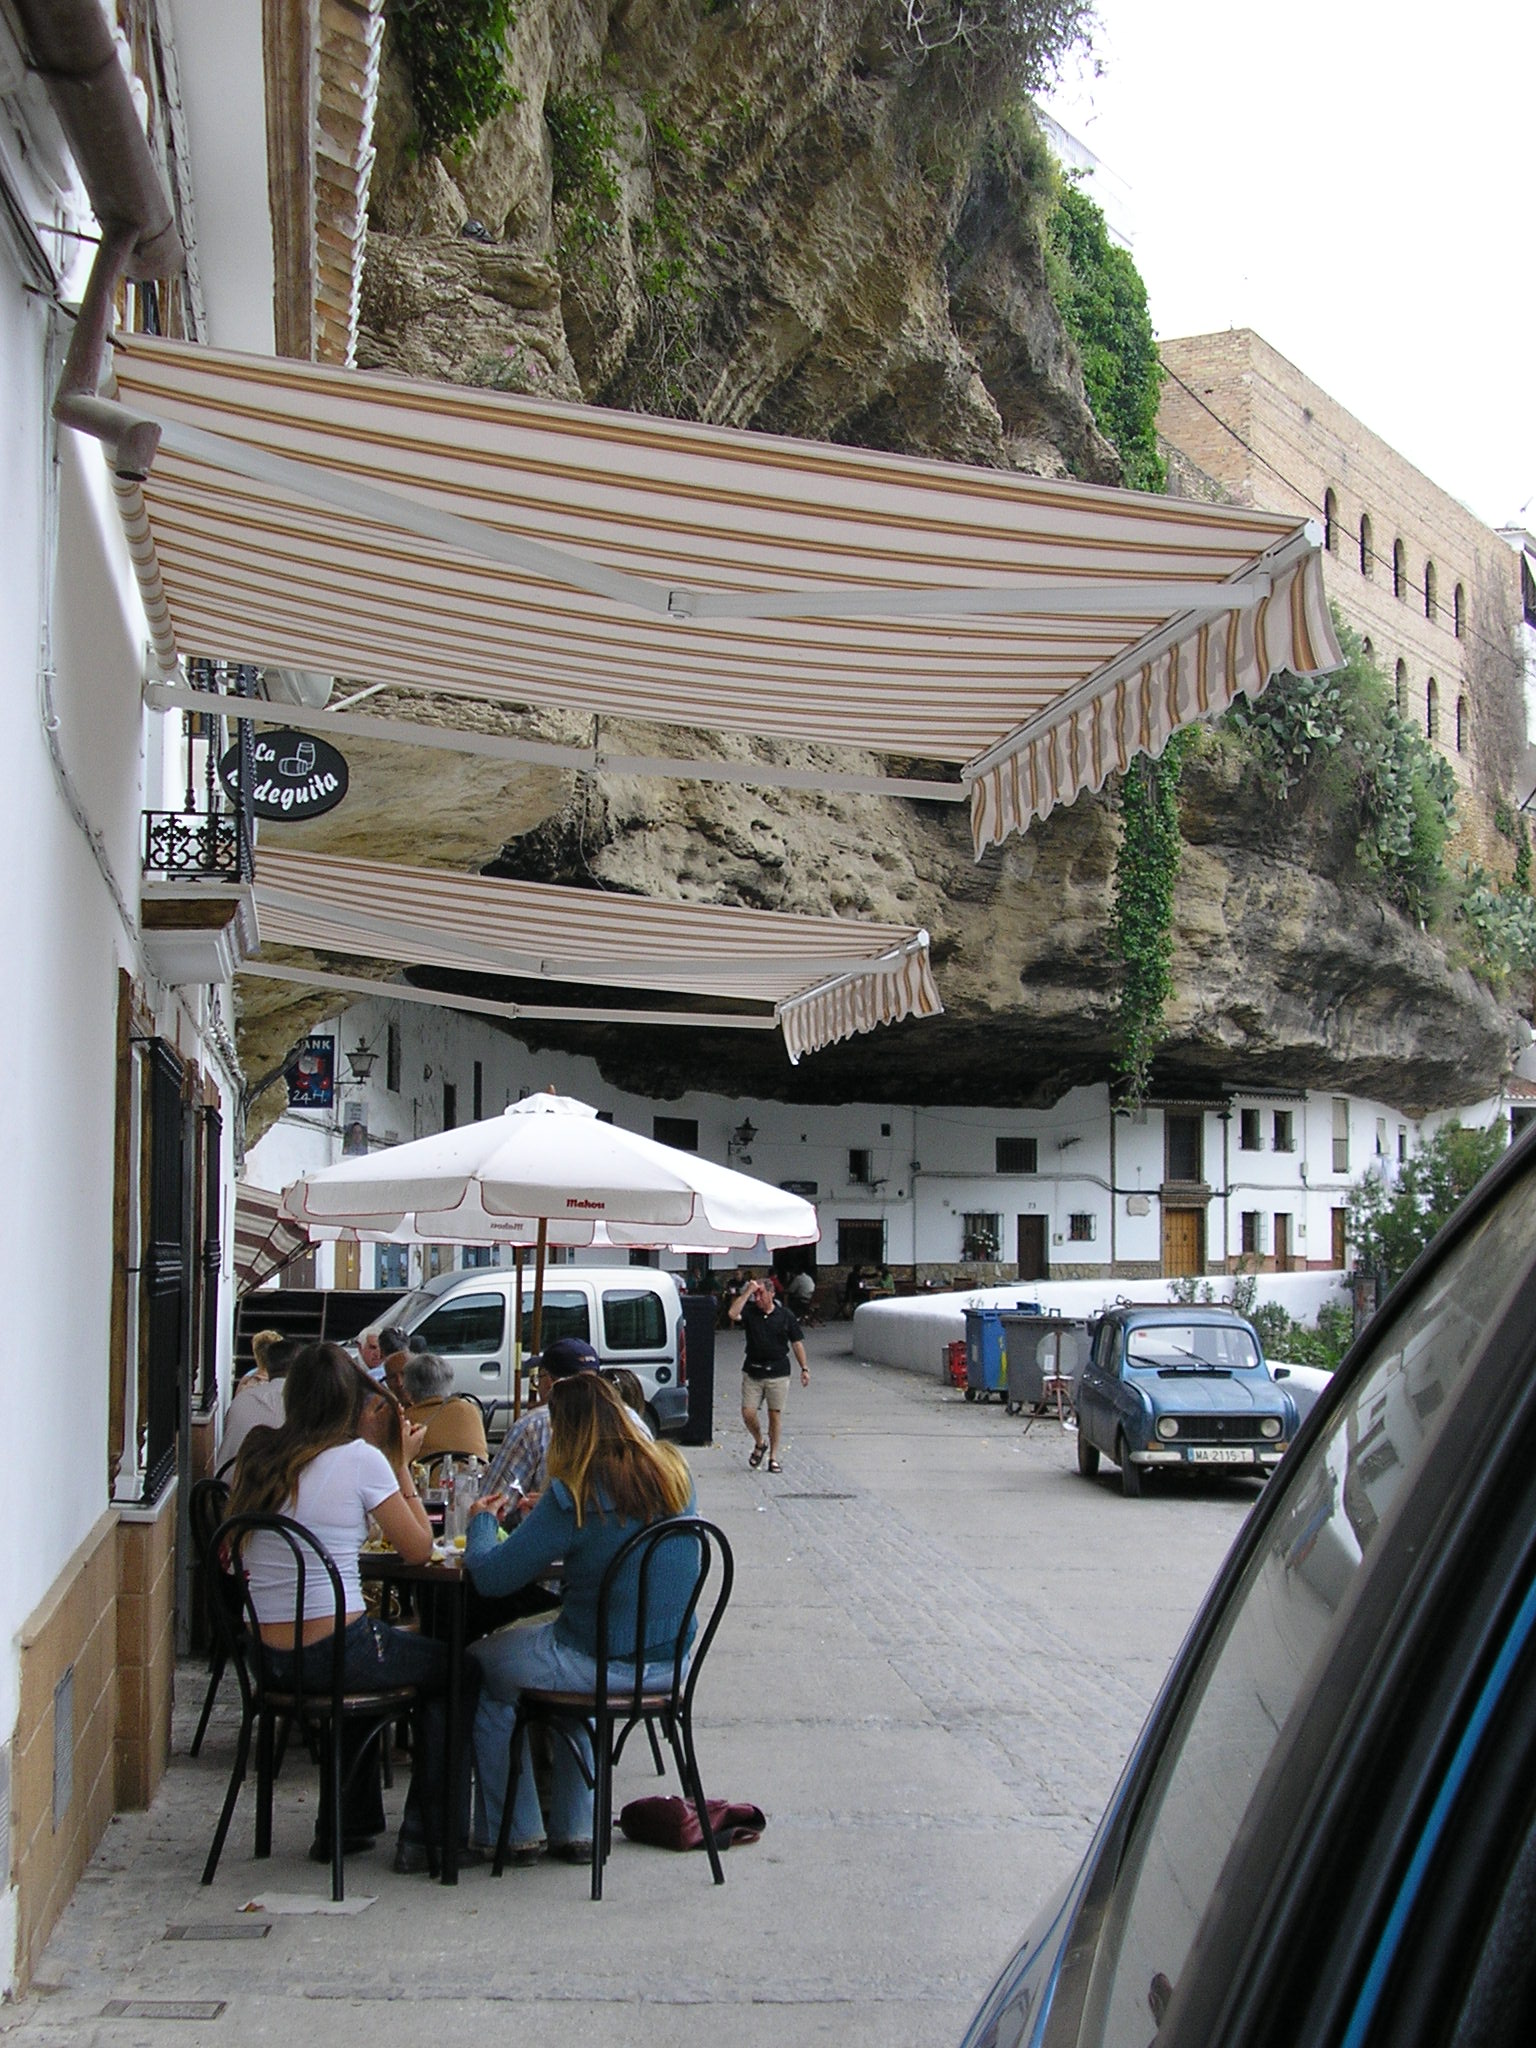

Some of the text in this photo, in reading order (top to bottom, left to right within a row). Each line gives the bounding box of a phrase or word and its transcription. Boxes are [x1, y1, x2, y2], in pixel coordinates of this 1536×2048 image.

[255, 743, 276, 762] La
[226, 768, 339, 811] deguita
[303, 1040, 331, 1050] ANK
[566, 1199, 605, 1209] Mahou
